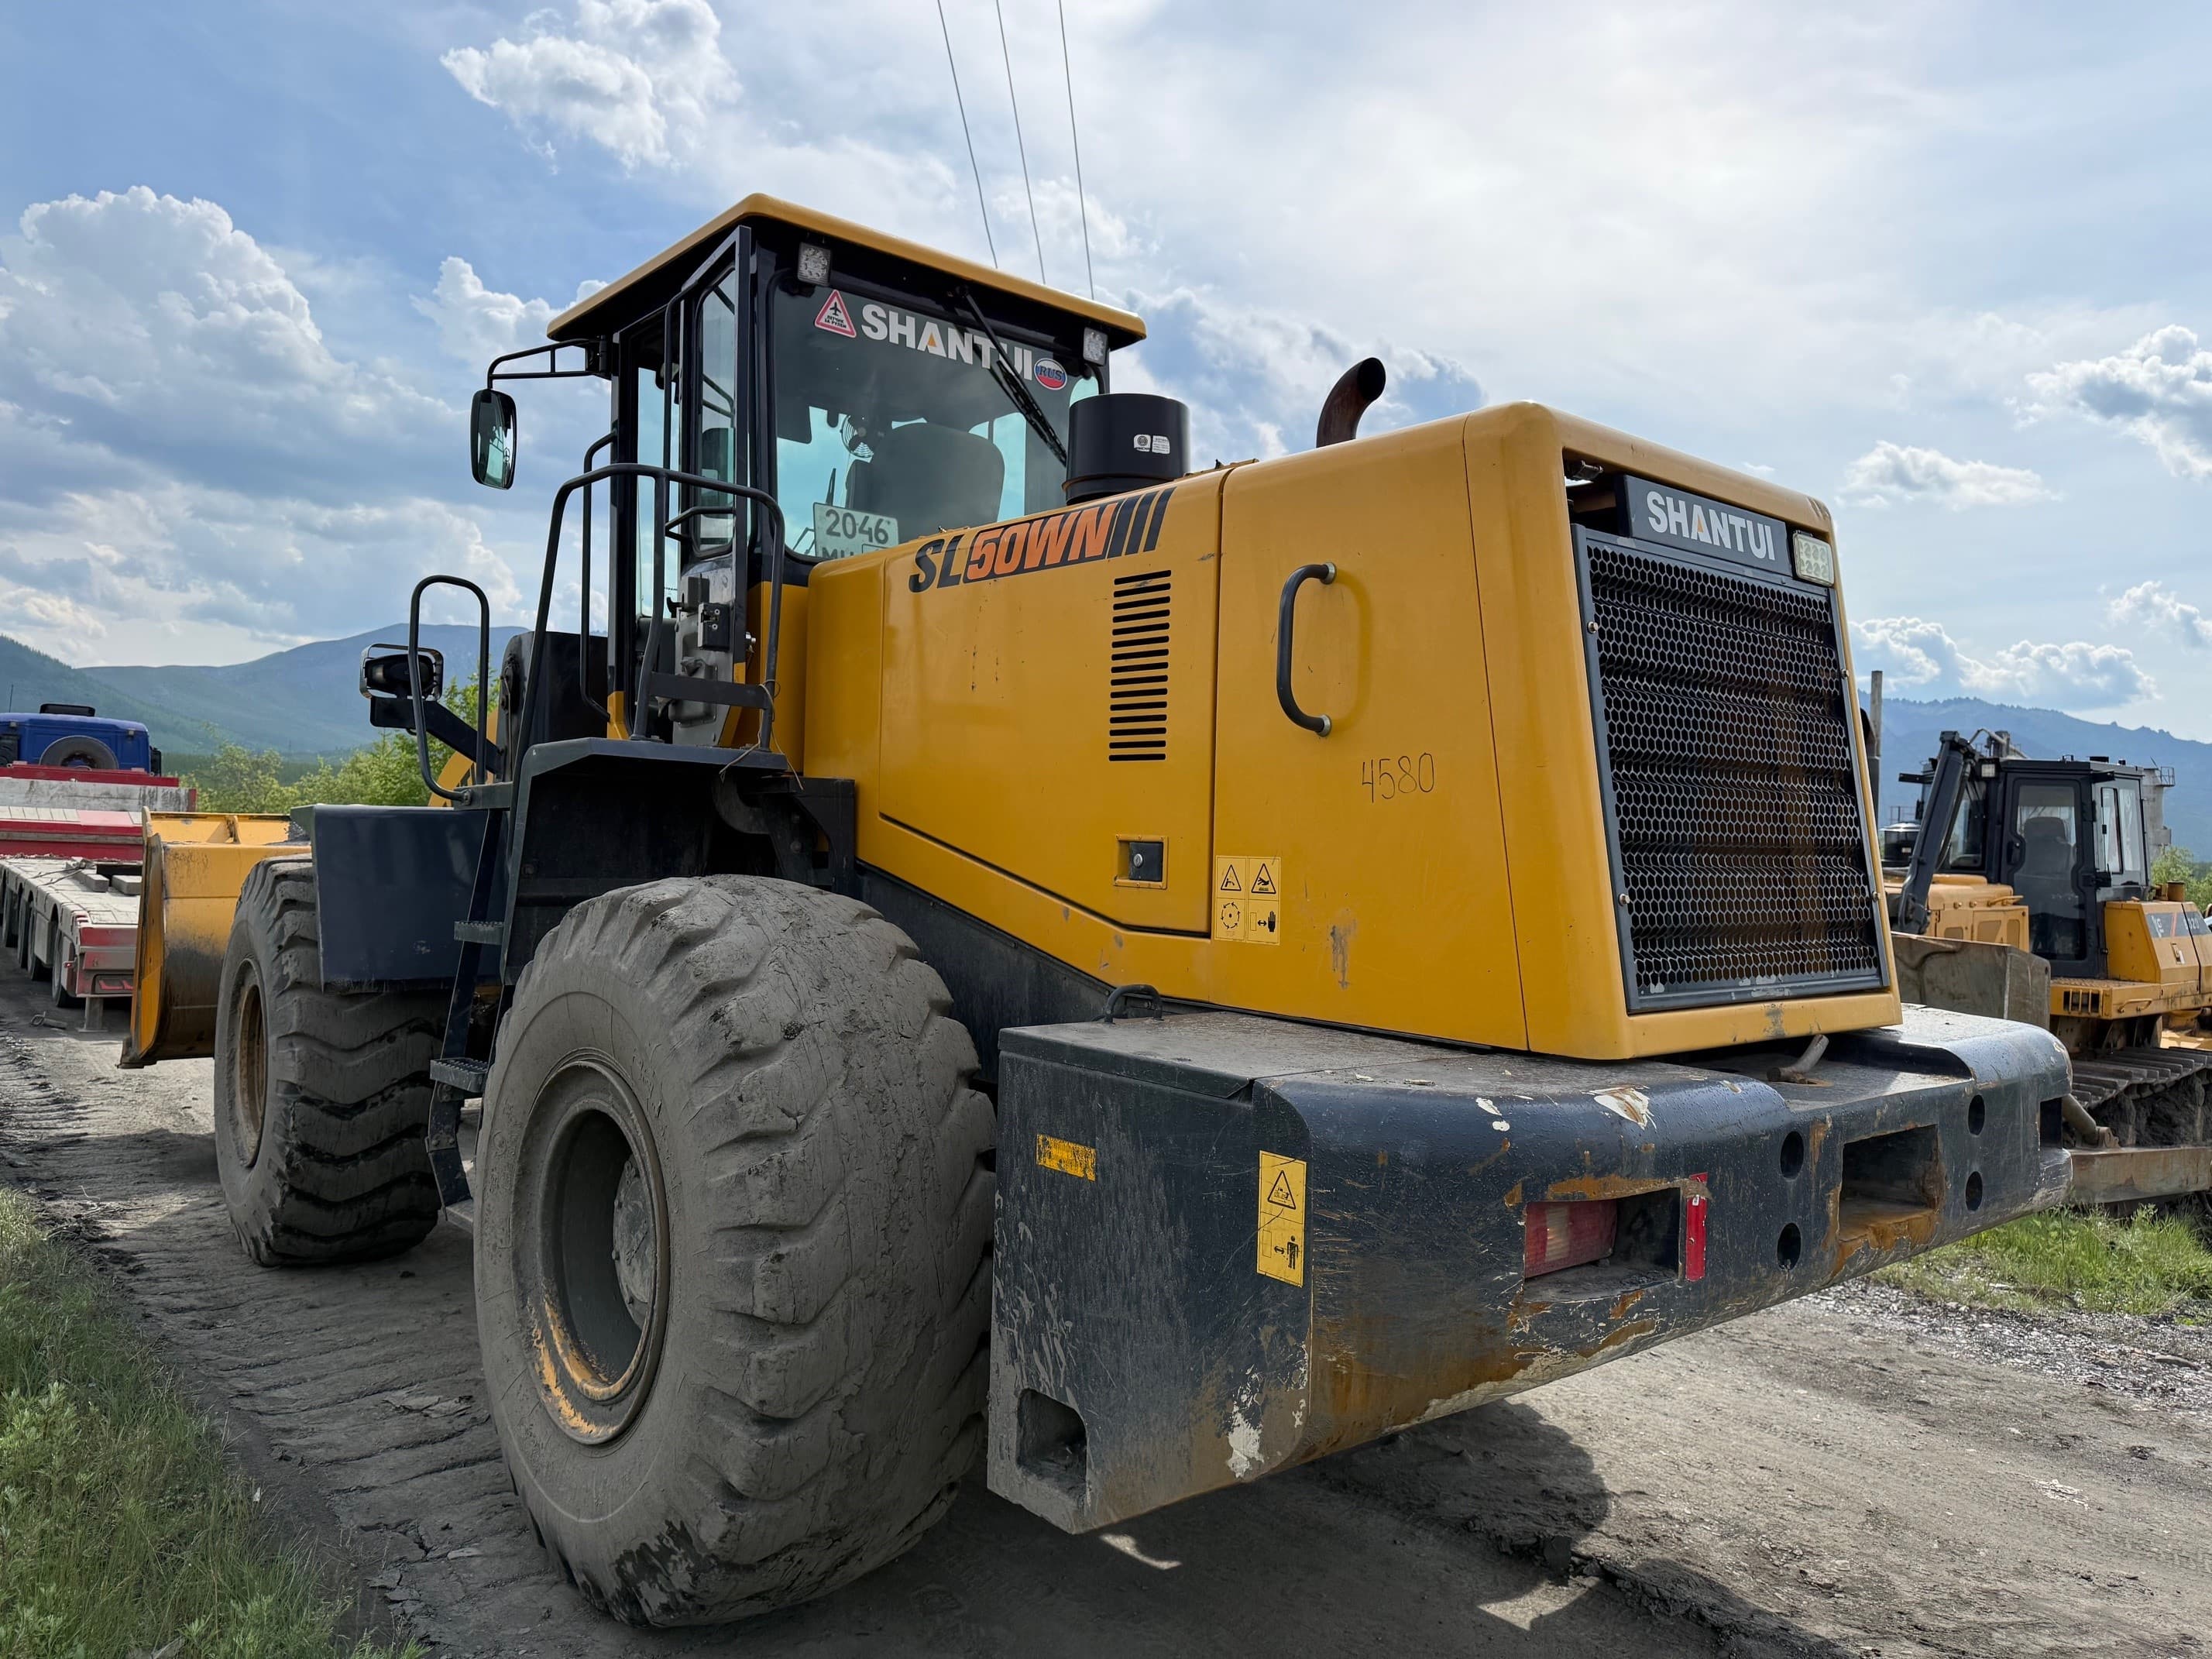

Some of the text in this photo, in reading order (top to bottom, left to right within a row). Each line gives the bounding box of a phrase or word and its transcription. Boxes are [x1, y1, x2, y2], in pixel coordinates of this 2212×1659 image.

[861, 304, 1032, 381] SHANTUI
[1039, 364, 1062, 381] RUS
[826, 509, 888, 544] 2046
[908, 502, 1119, 593] SL50WN
[1647, 491, 1776, 561] SHANTUI
[1362, 752, 1434, 803] 4580
